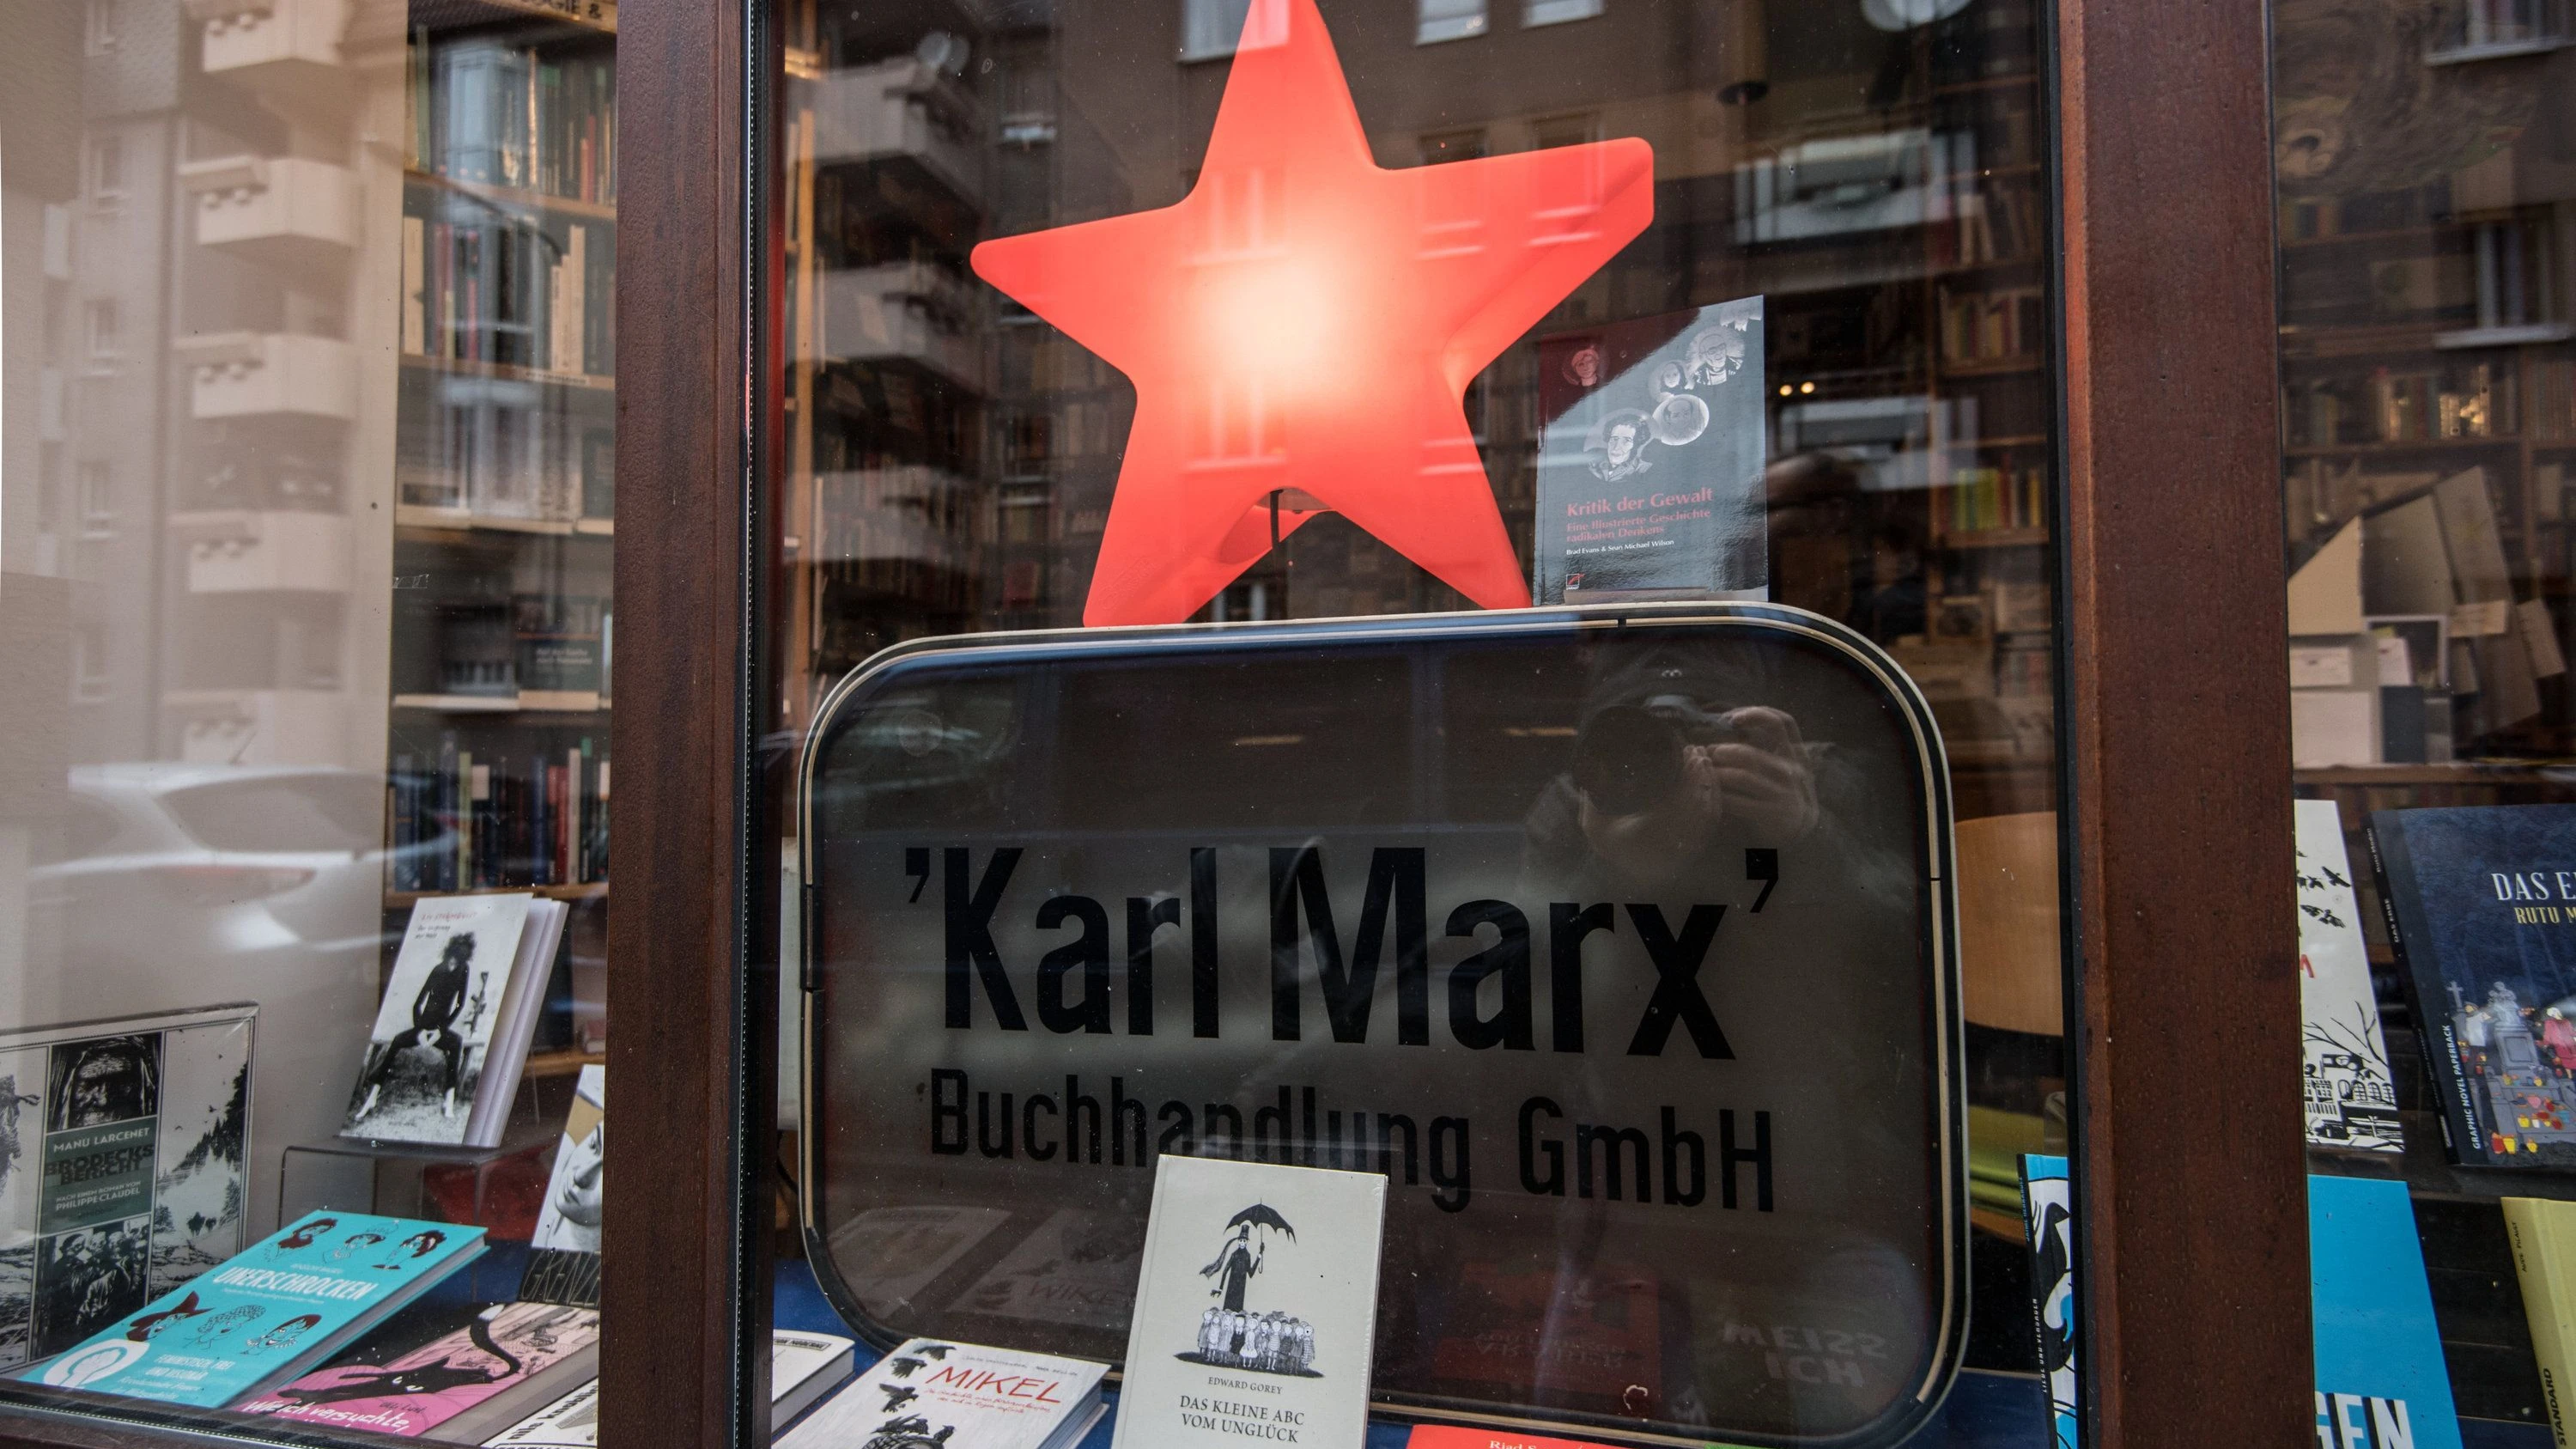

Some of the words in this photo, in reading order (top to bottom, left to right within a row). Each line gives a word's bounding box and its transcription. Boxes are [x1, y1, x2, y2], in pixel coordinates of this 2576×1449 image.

[1566, 498, 1611, 516] Kritik
[1617, 496, 1644, 511] der
[1650, 487, 1714, 508] Gewalt
[1566, 522, 1587, 532] Eine
[1649, 509, 1710, 523] Geschichte
[1566, 531, 1614, 543] radikalen
[1618, 525, 1664, 537] Denkens
[1624, 541, 1650, 550] Michael
[2491, 872, 2549, 900] DAS
[2514, 907, 2561, 924] RUTU
[2442, 1025, 2464, 1075] PAPERBACK
[2456, 1077, 2470, 1106] NOVEL
[53, 1138, 90, 1153] MANU
[94, 1127, 150, 1145] LARCENET
[931, 1068, 1472, 1213] Buchhandlung
[1518, 1096, 1773, 1212] GmbH
[2464, 1109, 2482, 1149] GRAPHIC
[45, 1144, 155, 1175] BRODECKS
[60, 1157, 141, 1185] BERICHT
[56, 1194, 76, 1202] NACH
[77, 1190, 97, 1199] EINEM
[99, 1184, 125, 1194] ROMAN
[56, 1196, 98, 1211] PHILIPPE
[99, 1187, 141, 1202] CLAUDEL
[212, 1266, 379, 1301] UNERSCHROCKEN
[925, 1366, 1061, 1403] MIKEL
[1208, 1376, 1248, 1389] EDWARD
[1249, 1383, 1283, 1395] GOREY
[241, 1400, 283, 1415] Wie
[282, 1401, 315, 1414] ich
[309, 1407, 410, 1434] versuchte,
[537, 1385, 598, 1420] knoblic
[1180, 1395, 1208, 1411] DAS
[1212, 1400, 1268, 1420] KLEINE
[1273, 1409, 1304, 1425] ABC
[2543, 1367, 2567, 1447] STANDARD
[1182, 1413, 1217, 1430] VOM
[1222, 1419, 1299, 1443] UNGLÜCK
[2314, 1391, 2415, 1449] EN
